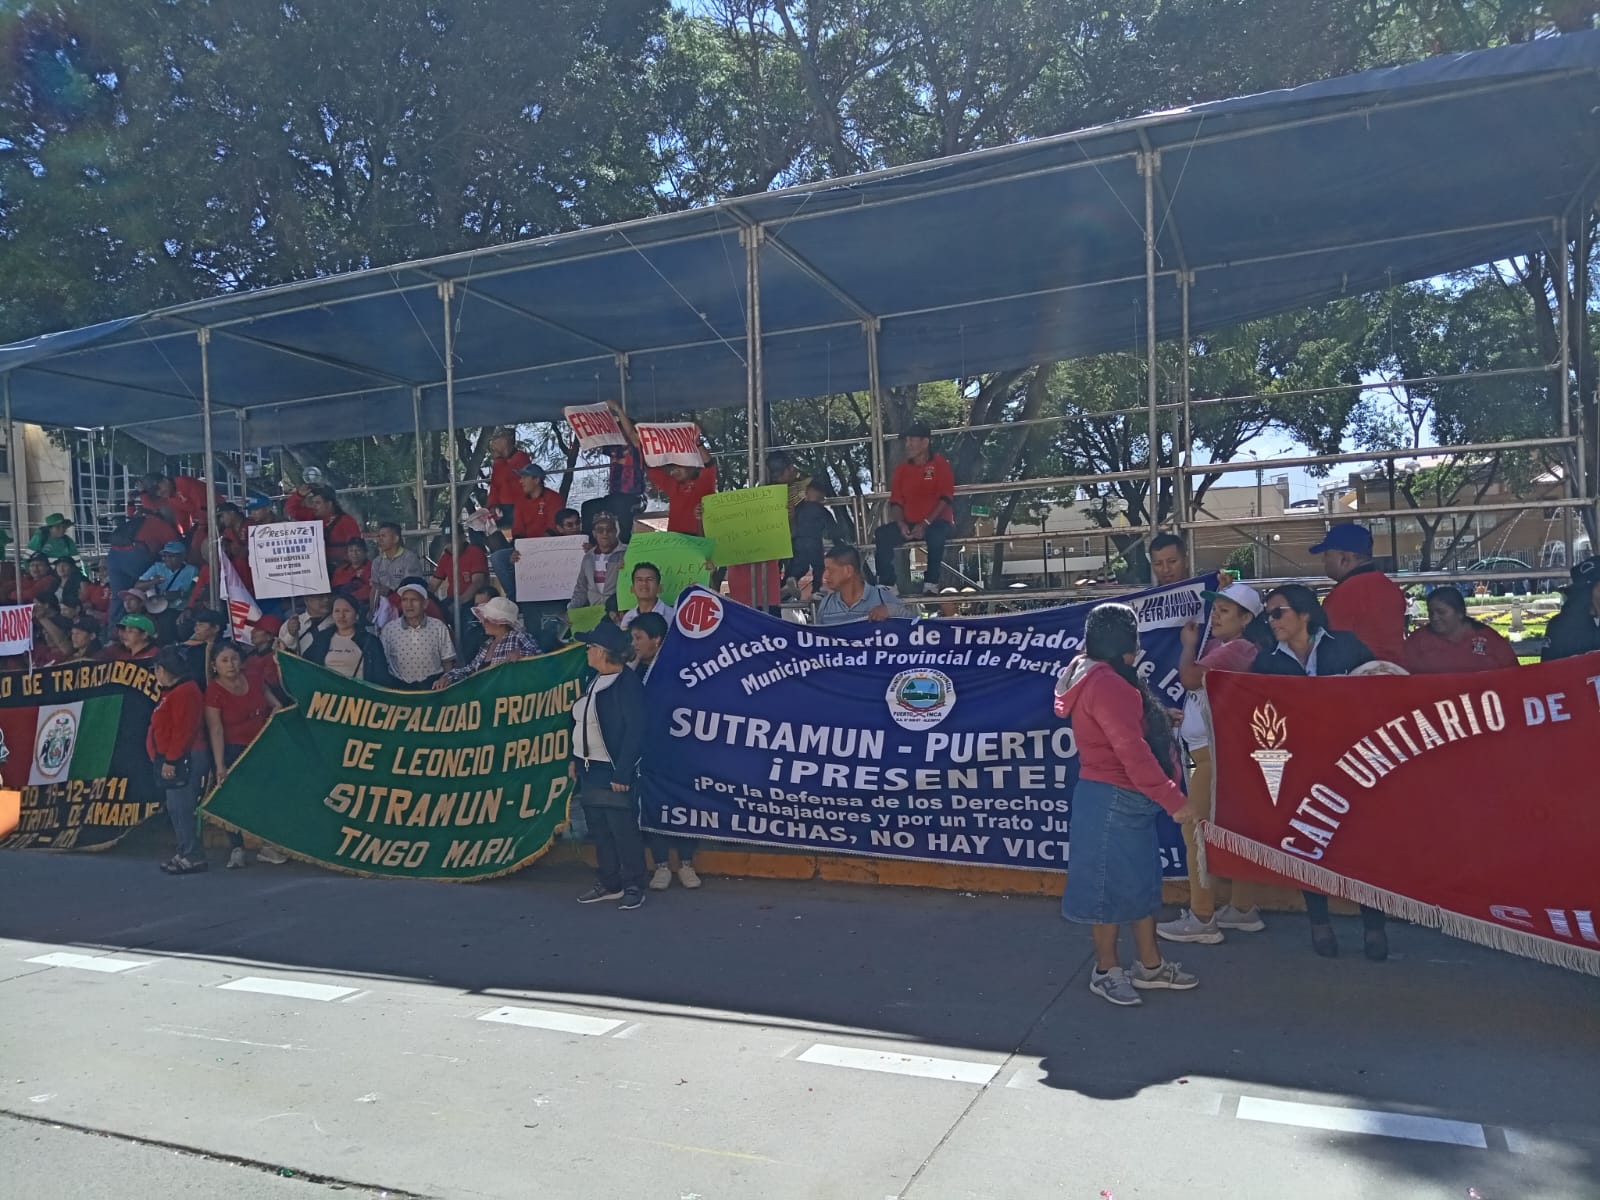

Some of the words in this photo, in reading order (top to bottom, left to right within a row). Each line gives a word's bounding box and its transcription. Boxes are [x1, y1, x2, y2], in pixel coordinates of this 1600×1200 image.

[22, 673, 43, 696] DE
[52, 661, 162, 702] TRABAJADORES
[679, 634, 788, 688] Sindicato
[797, 629, 899, 648] Unitario
[909, 625, 941, 646] de
[1158, 668, 1185, 701] la
[741, 651, 867, 695] Municipalidad
[875, 650, 970, 667] Provincial
[977, 650, 1000, 666] de
[306, 691, 481, 733] MUNICIPALIDAD
[493, 678, 581, 728] PROVINCI
[342, 738, 382, 770] DE
[392, 744, 495, 778] LEONCIO
[502, 729, 568, 772] PRADO
[669, 707, 885, 760] SUTRAMUN
[925, 727, 1078, 763] PUERTO
[1335, 690, 1506, 788] UNITARIO
[1522, 692, 1572, 726] DE
[694, 776, 736, 794] ¡Por
[743, 784, 763, 798] la
[769, 788, 863, 808] Defensa
[871, 795, 900, 809] de
[908, 794, 943, 809] los
[951, 795, 1069, 813] Derechos
[769, 757, 1067, 791] ¡PRESENTE!
[660, 805, 720, 829] ¡SIN
[731, 814, 858, 845] LUCHAS,
[870, 830, 915, 849] NO
[928, 832, 990, 855] HAY
[734, 797, 872, 823] Trabajadores
[878, 814, 892, 827] y
[898, 812, 932, 828] por
[940, 814, 966, 828] un
[973, 812, 1033, 831] Trato
[1040, 815, 1071, 833] Ju
[335, 826, 430, 868] TINGO
